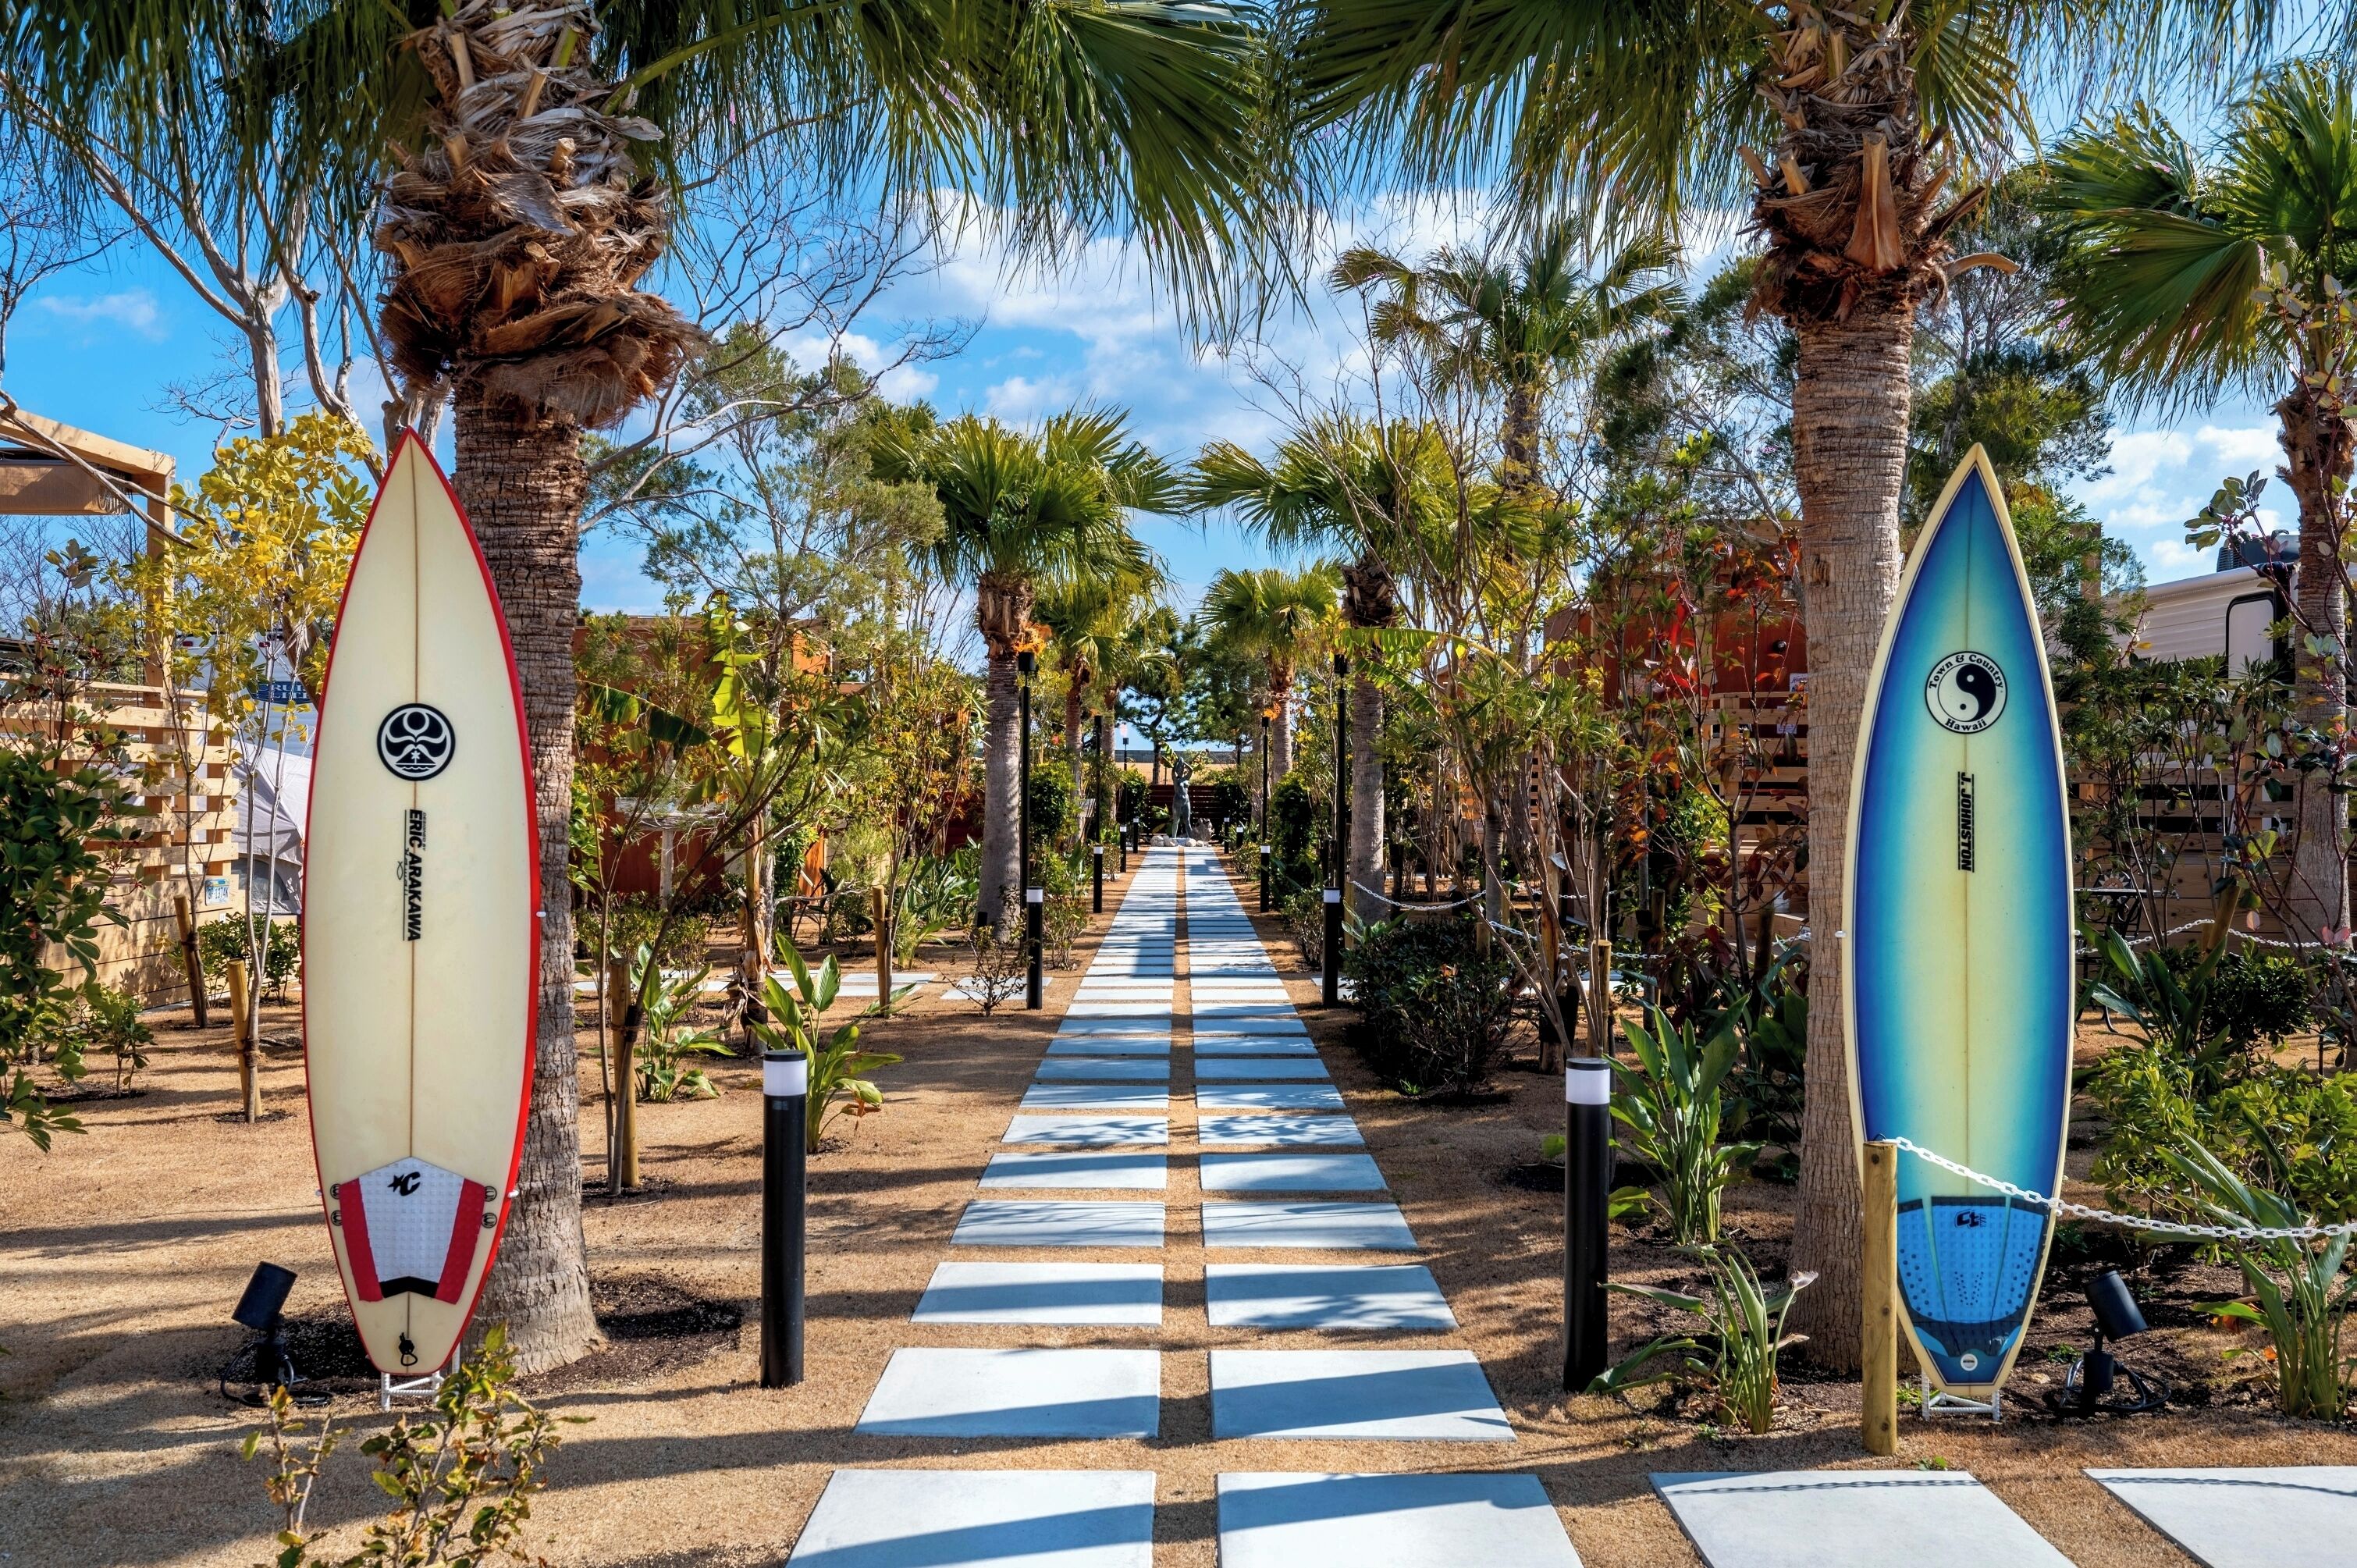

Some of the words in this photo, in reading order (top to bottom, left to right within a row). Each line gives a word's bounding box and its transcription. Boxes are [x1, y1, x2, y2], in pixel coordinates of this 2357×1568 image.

[1929, 661, 1953, 689] Town
[1955, 654, 1964, 663] &
[1968, 654, 2003, 688] Country
[1945, 718, 1987, 731] Hawaii
[1961, 772, 1971, 785] J.
[409, 809, 423, 848] ERIC
[1961, 788, 1972, 872] JOHNSTON
[407, 852, 422, 941] ARAKAWA
